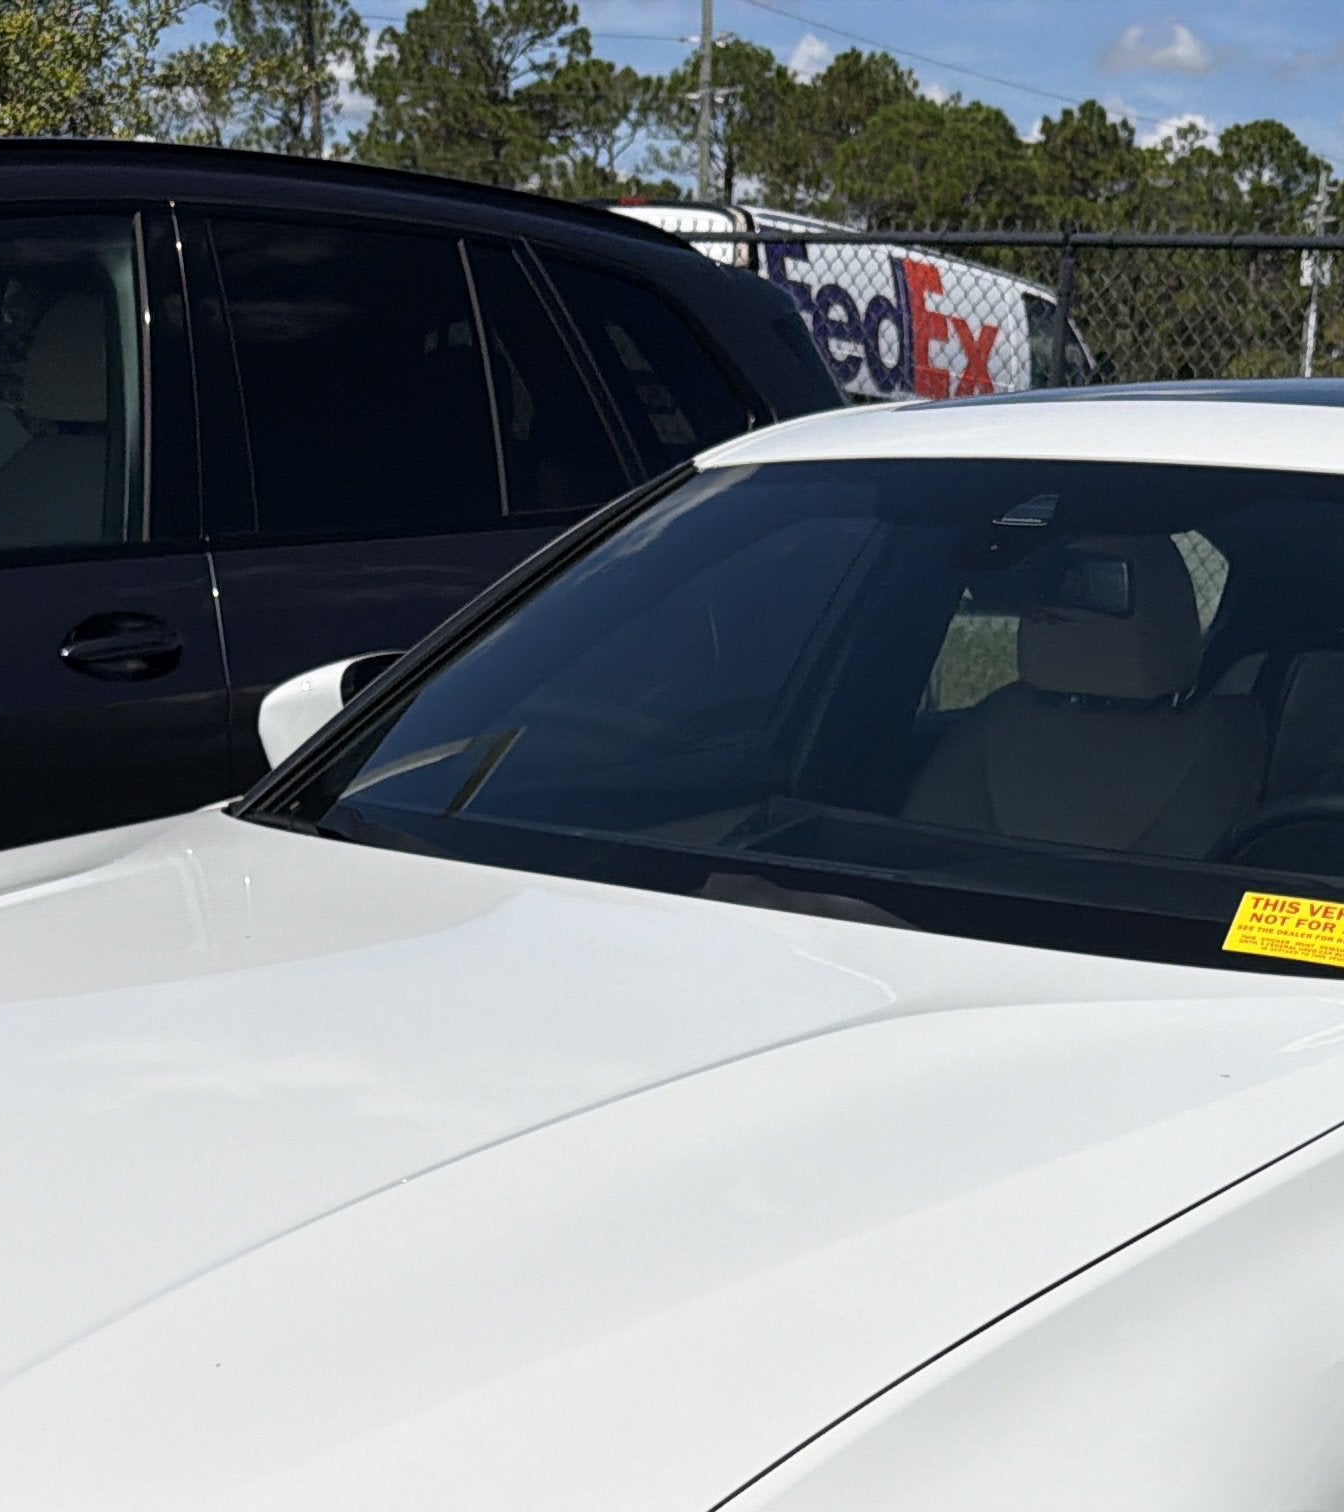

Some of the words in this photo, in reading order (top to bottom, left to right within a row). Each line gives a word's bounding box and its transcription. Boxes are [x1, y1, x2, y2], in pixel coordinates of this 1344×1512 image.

[761, 228, 999, 399] FedEx
[1251, 897, 1301, 914] THIS
[1249, 913, 1289, 925] NOT
[1294, 919, 1336, 932] FOR
[1258, 926, 1274, 934] THE
[1277, 929, 1313, 939] DEALER
